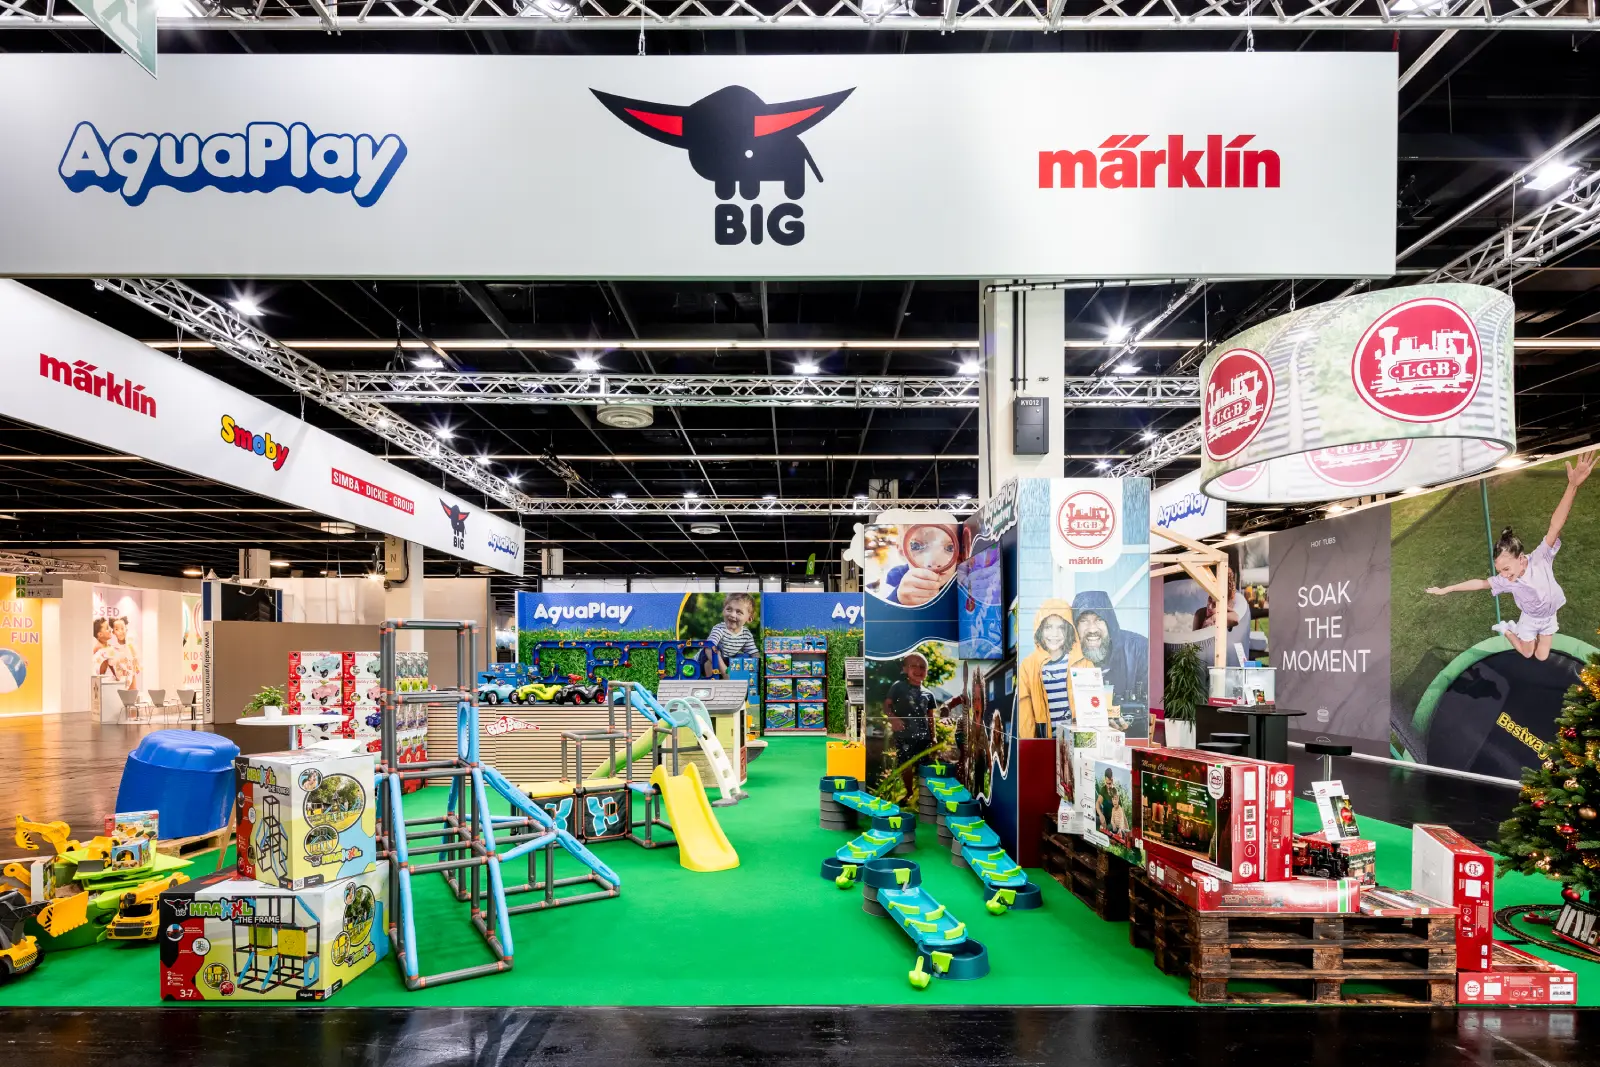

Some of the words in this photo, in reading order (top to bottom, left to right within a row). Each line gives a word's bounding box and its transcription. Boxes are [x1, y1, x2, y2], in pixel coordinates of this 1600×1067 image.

[58, 121, 408, 207] AquaPlay
[714, 203, 805, 246] BIG
[221, 414, 289, 471] Smoby
[333, 471, 360, 492] SIMBA
[366, 485, 388, 503] DICKIE
[393, 496, 414, 513] GROUP
[1157, 493, 1209, 528] AquaPlay
[453, 536, 464, 550] BIG
[1323, 537, 1336, 545] TUBS
[1297, 580, 1351, 607] SOAK
[0, 616, 33, 628] AND
[533, 602, 633, 625] AquaPlay
[11, 632, 39, 644] FUN
[1304, 615, 1343, 639] THE
[1282, 649, 1371, 673] MOMENT
[190, 899, 254, 919] KRAXXL
[238, 916, 253, 924] THE
[254, 916, 280, 924] FRAME
